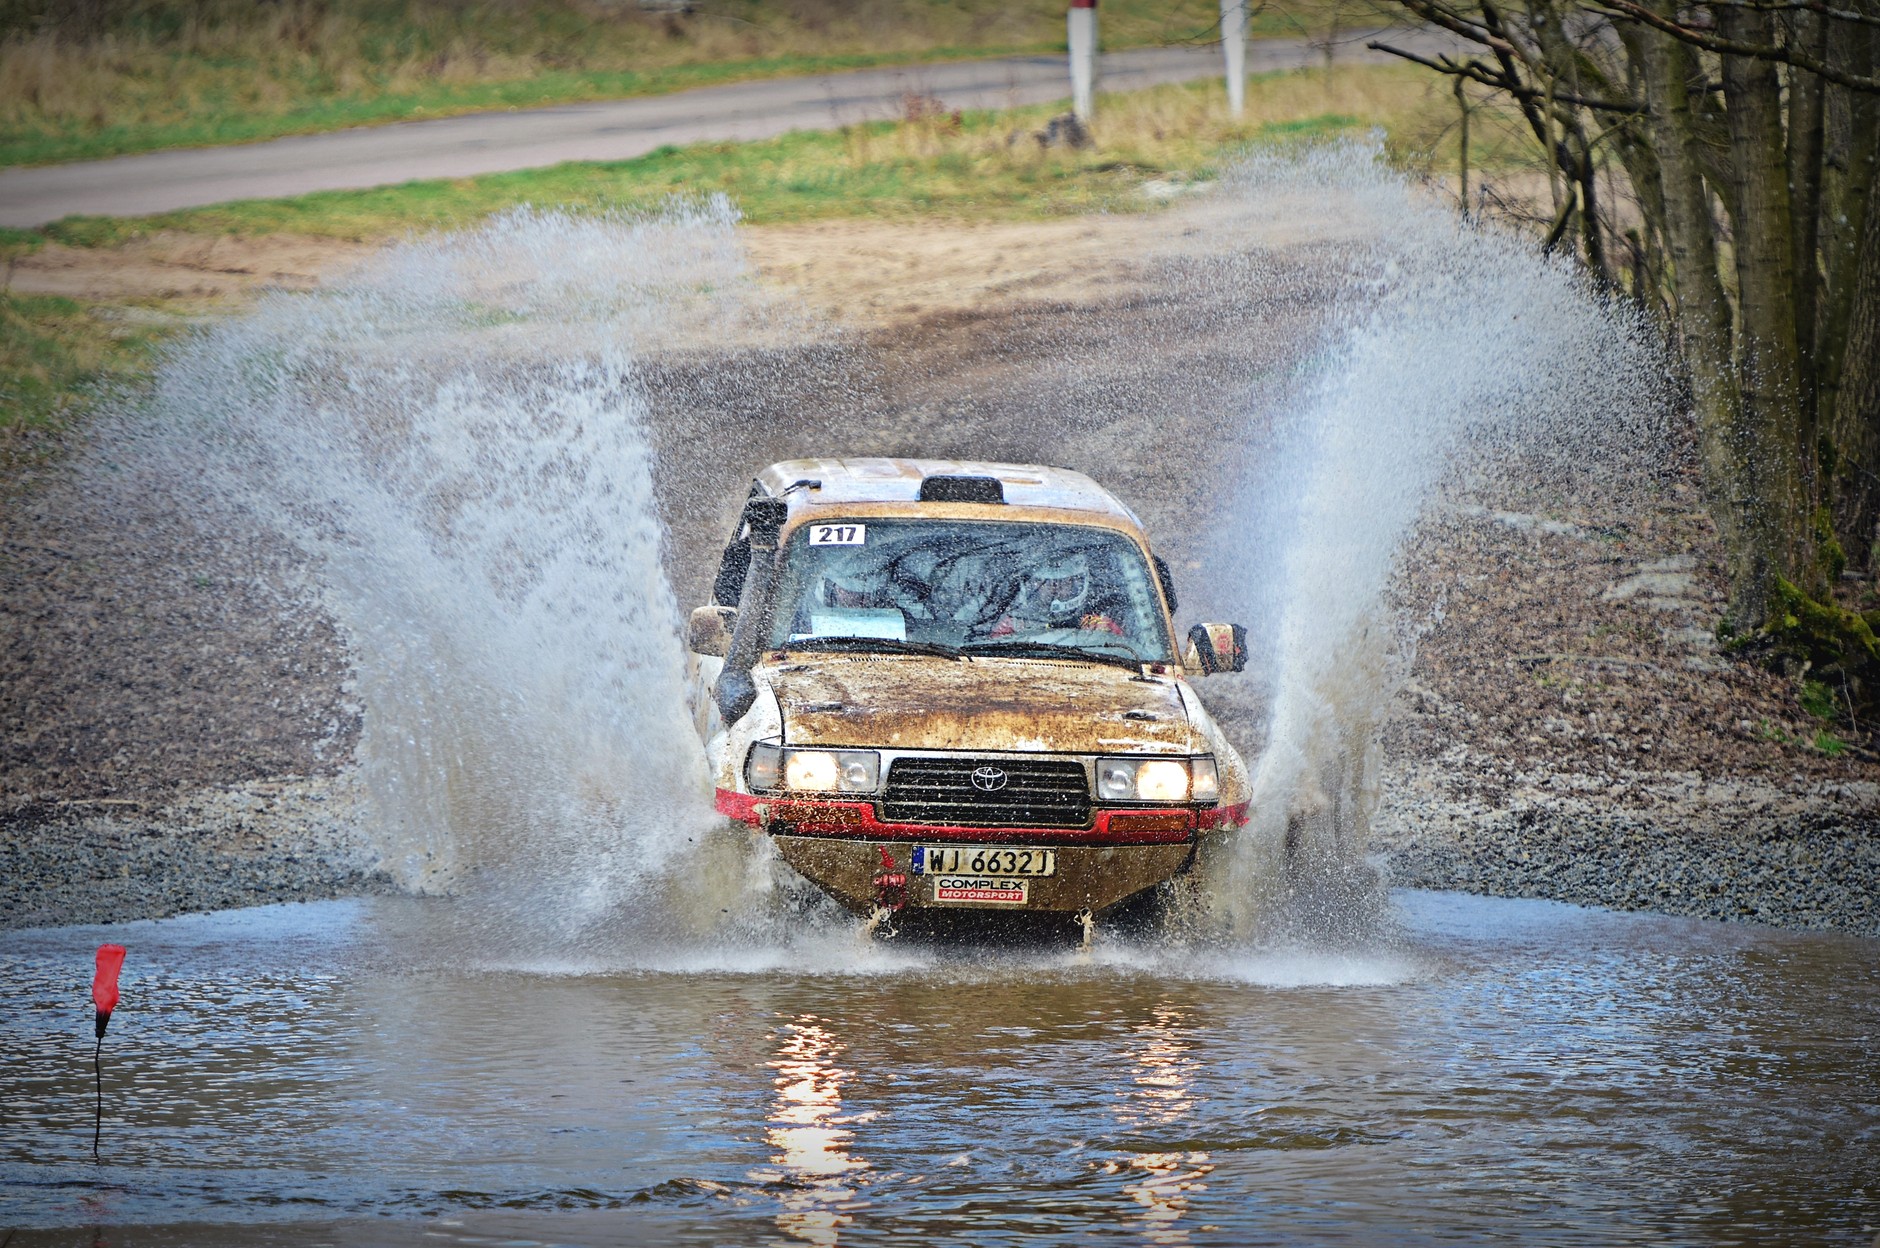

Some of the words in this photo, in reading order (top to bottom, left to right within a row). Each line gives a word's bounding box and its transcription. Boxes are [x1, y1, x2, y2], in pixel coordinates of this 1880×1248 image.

[818, 527, 857, 542] 217
[930, 850, 959, 872] WJ
[971, 851, 1047, 874] 6632J
[939, 879, 1023, 890] COMPLEX
[941, 890, 1022, 900] MOTORSPORT
